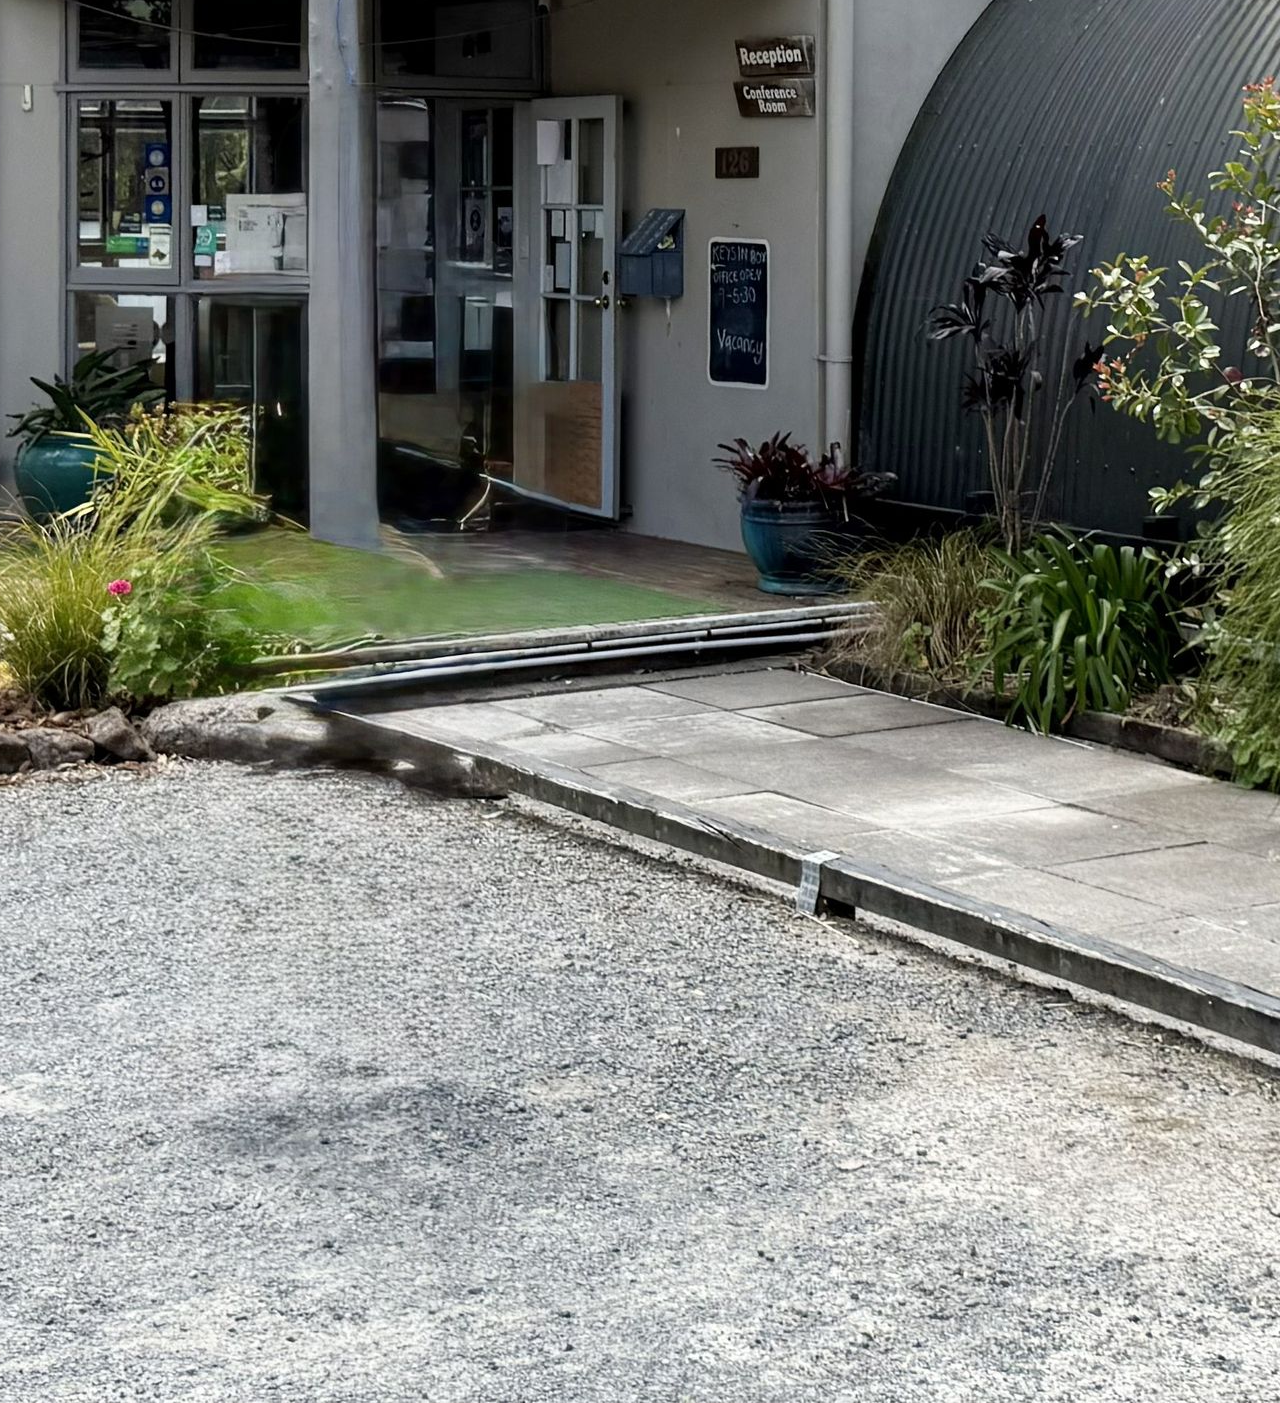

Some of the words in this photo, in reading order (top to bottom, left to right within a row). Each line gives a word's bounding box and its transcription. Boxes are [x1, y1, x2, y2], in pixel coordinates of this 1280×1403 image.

[739, 44, 802, 68] Reception
[742, 85, 798, 100] Conference
[758, 99, 788, 113] Room
[721, 149, 750, 174] 126
[712, 245, 737, 262] KEYS
[737, 245, 749, 262] IN
[713, 270, 739, 284] OFFICE
[739, 268, 762, 282] OPEN
[716, 328, 764, 365] Vacancy
